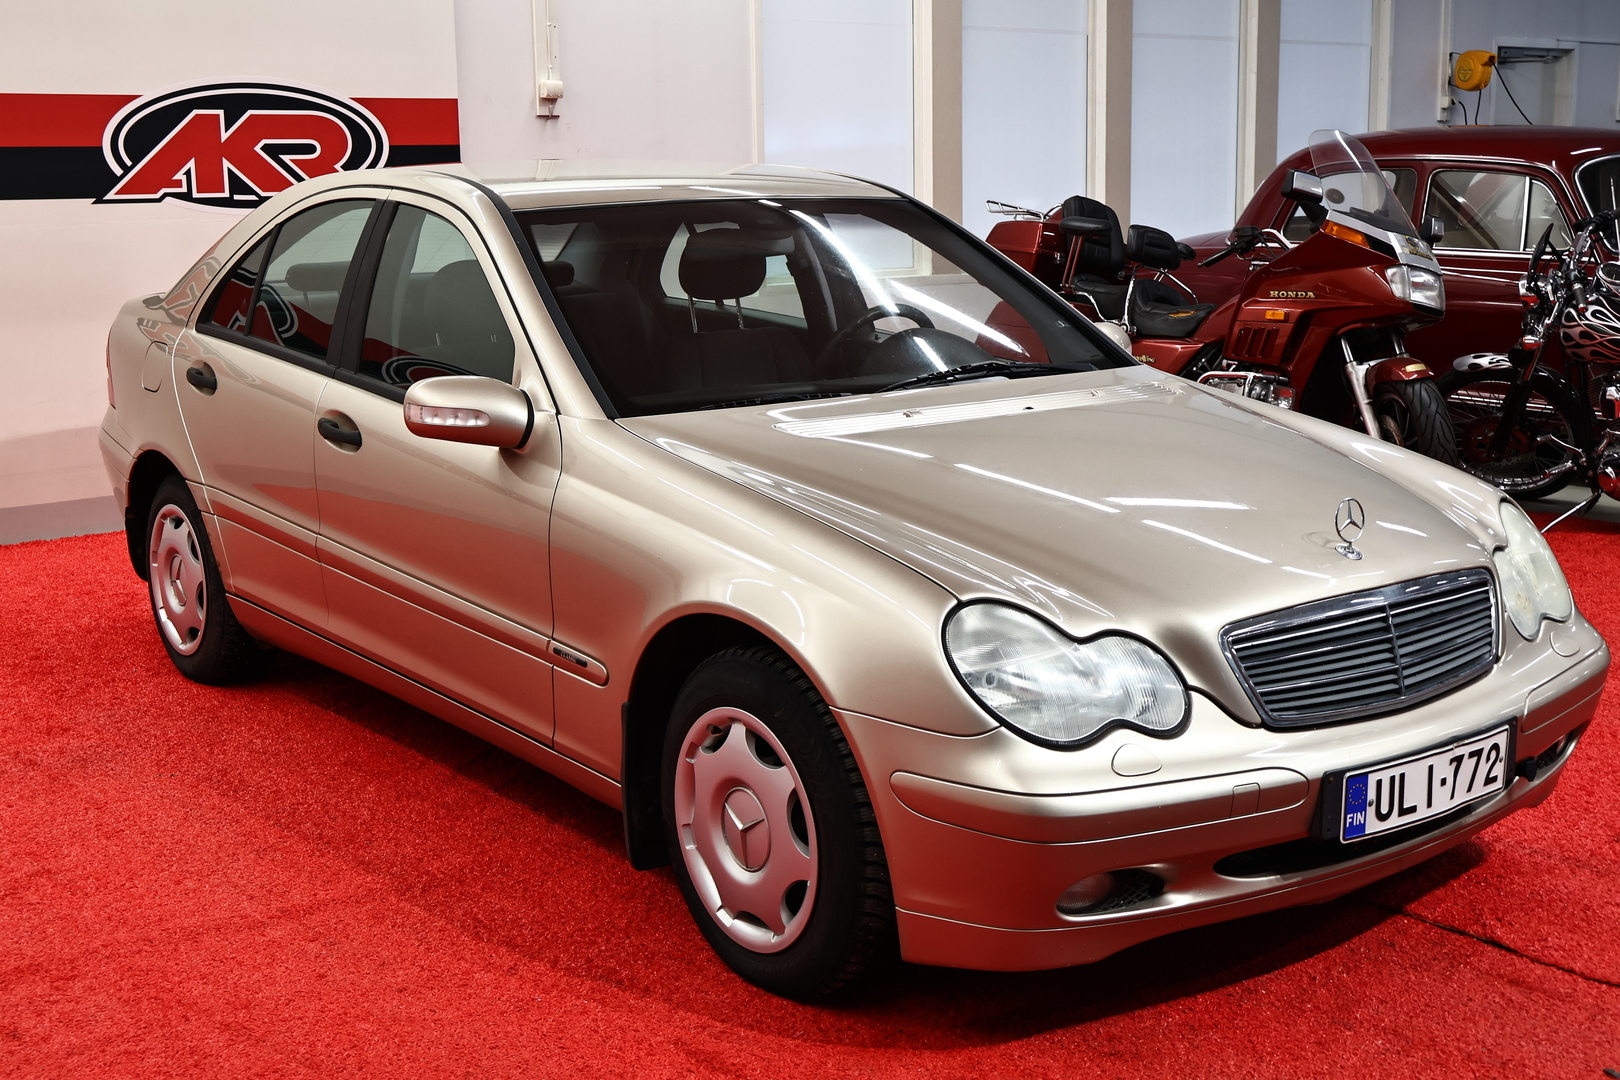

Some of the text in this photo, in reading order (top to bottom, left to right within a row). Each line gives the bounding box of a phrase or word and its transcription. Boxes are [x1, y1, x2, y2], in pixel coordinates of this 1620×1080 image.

[103, 109, 352, 199] AKR
[1269, 290, 1316, 298] HONDA
[1375, 742, 1501, 822] ULI-772
[1346, 811, 1366, 828] FIN
